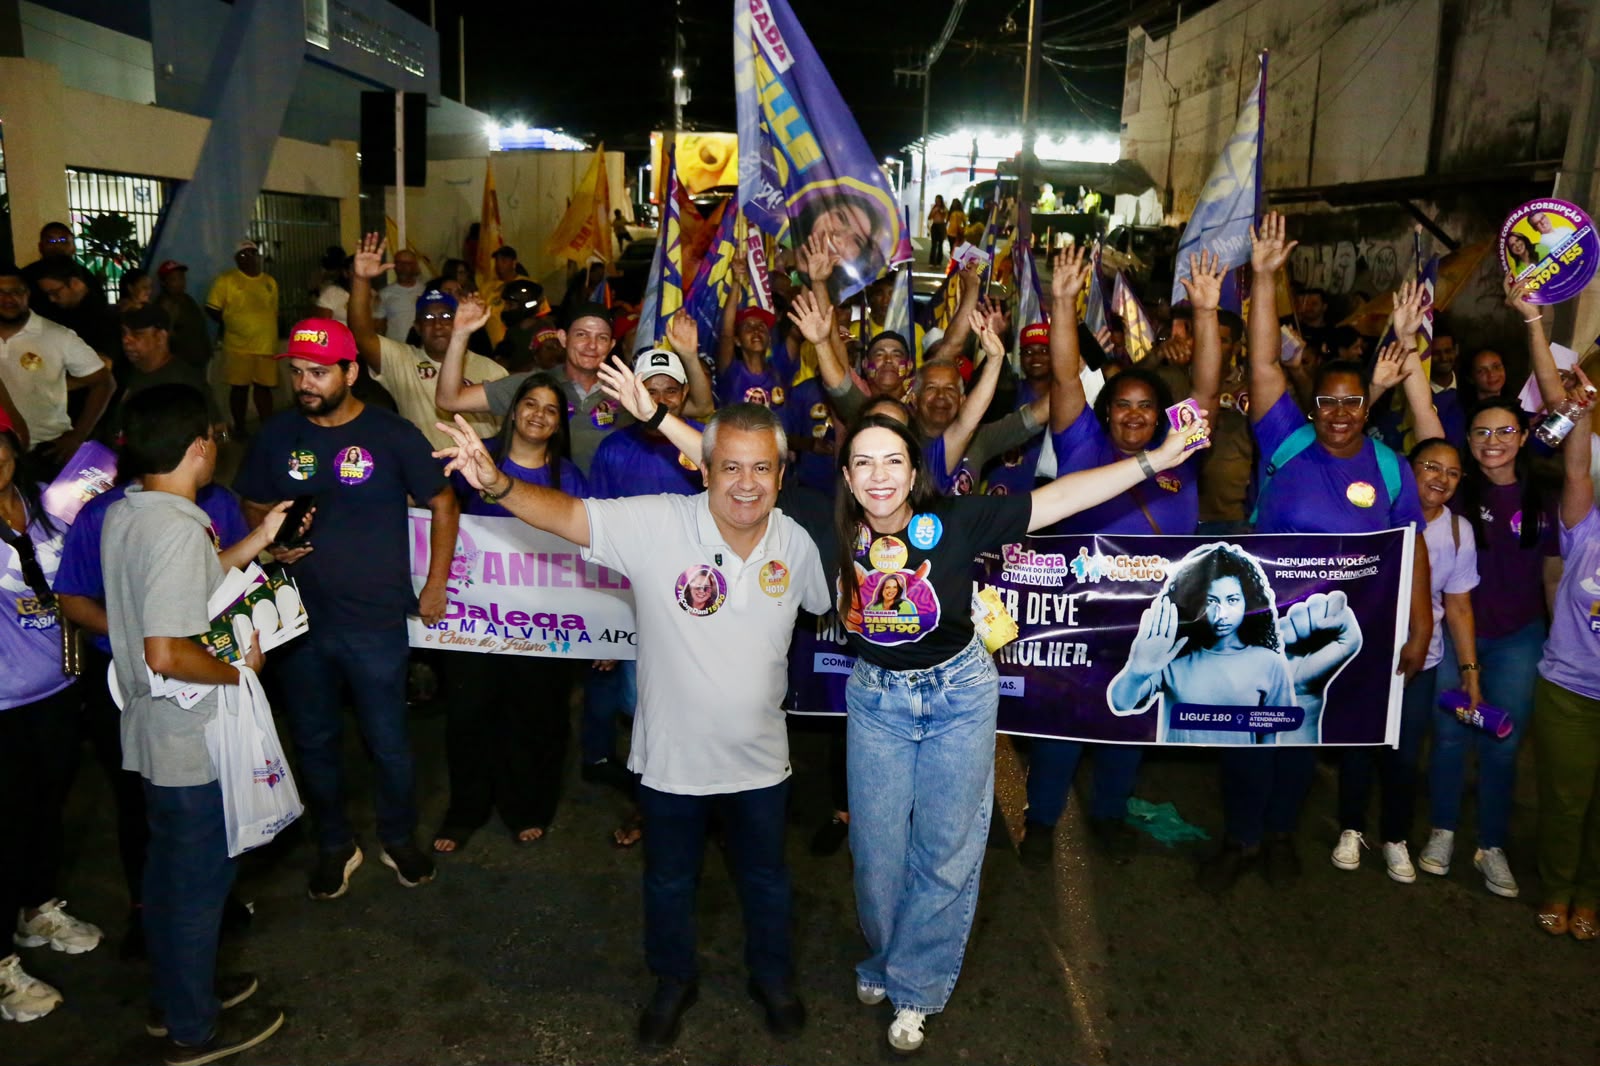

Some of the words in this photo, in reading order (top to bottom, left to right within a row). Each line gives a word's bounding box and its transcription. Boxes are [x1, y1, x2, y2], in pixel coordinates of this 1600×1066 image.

[1530, 202, 1582, 223] CORRUPÇÃO
[1560, 243, 1584, 266] 155
[915, 525, 935, 538] 55
[1005, 544, 1065, 568] Galega
[1277, 557, 1327, 567] DENUNCIE
[1327, 557, 1335, 566] A
[1013, 565, 1032, 573] CHAVE
[1275, 570, 1318, 579] PREVINA
[1319, 570, 1328, 579] O
[1011, 572, 1062, 586] MALVINA
[765, 585, 785, 595] 4010
[1026, 592, 1079, 627] DEVE
[864, 615, 920, 624] DANIELLE
[460, 619, 592, 644] MALVINA
[865, 624, 921, 635] 15190
[425, 634, 433, 642] e
[1001, 641, 1093, 668] MULHER.
[1000, 681, 1017, 690] AS.
[1179, 712, 1211, 722] LIGUE
[1212, 713, 1232, 722] 180
